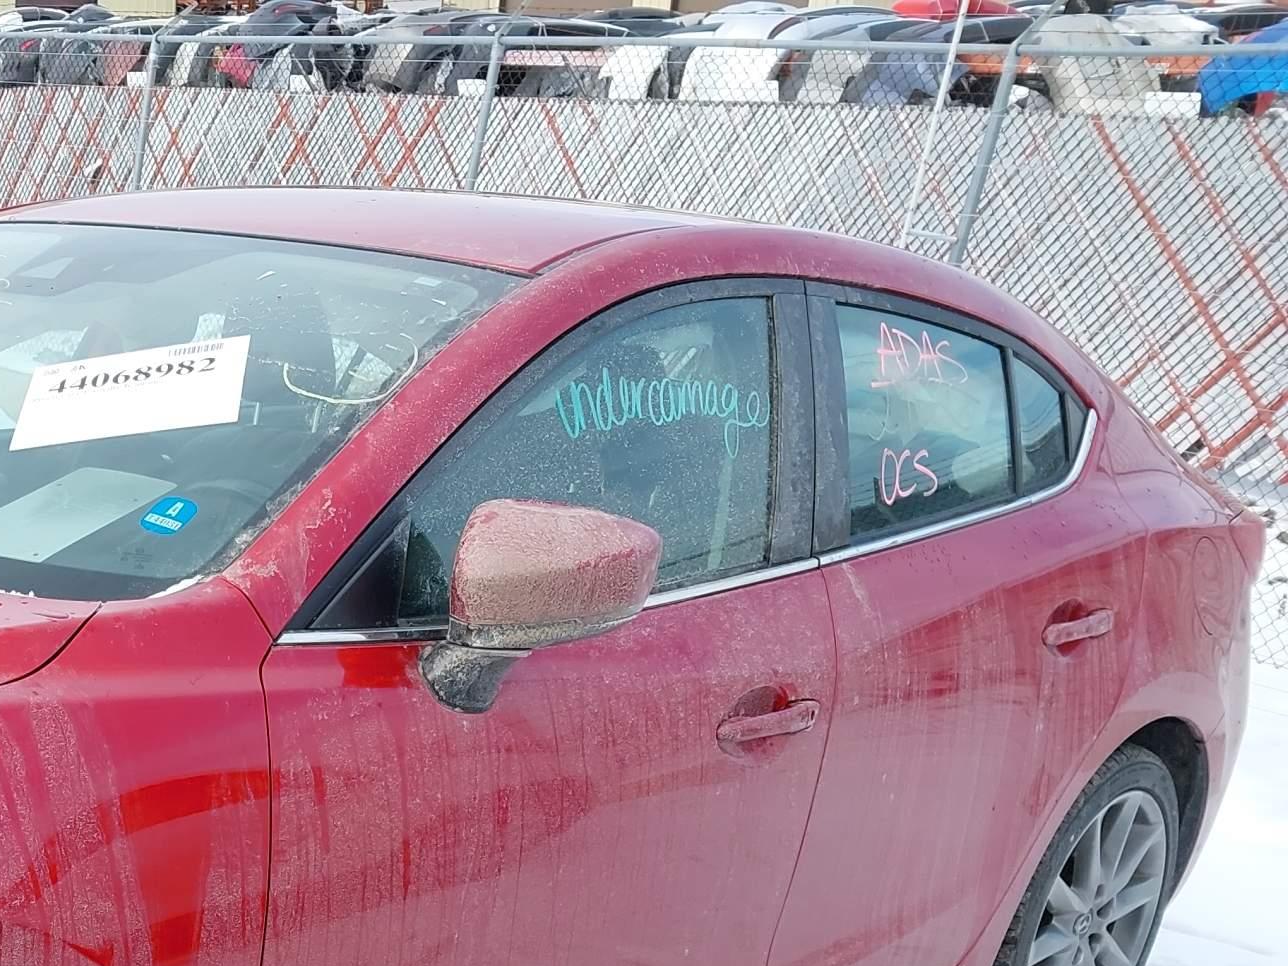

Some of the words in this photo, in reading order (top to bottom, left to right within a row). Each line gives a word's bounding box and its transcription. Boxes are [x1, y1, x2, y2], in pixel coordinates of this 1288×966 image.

[48, 356, 216, 393] 44068982
[876, 322, 969, 384] ADAS
[879, 447, 938, 506] OCS
[164, 501, 185, 517] A
